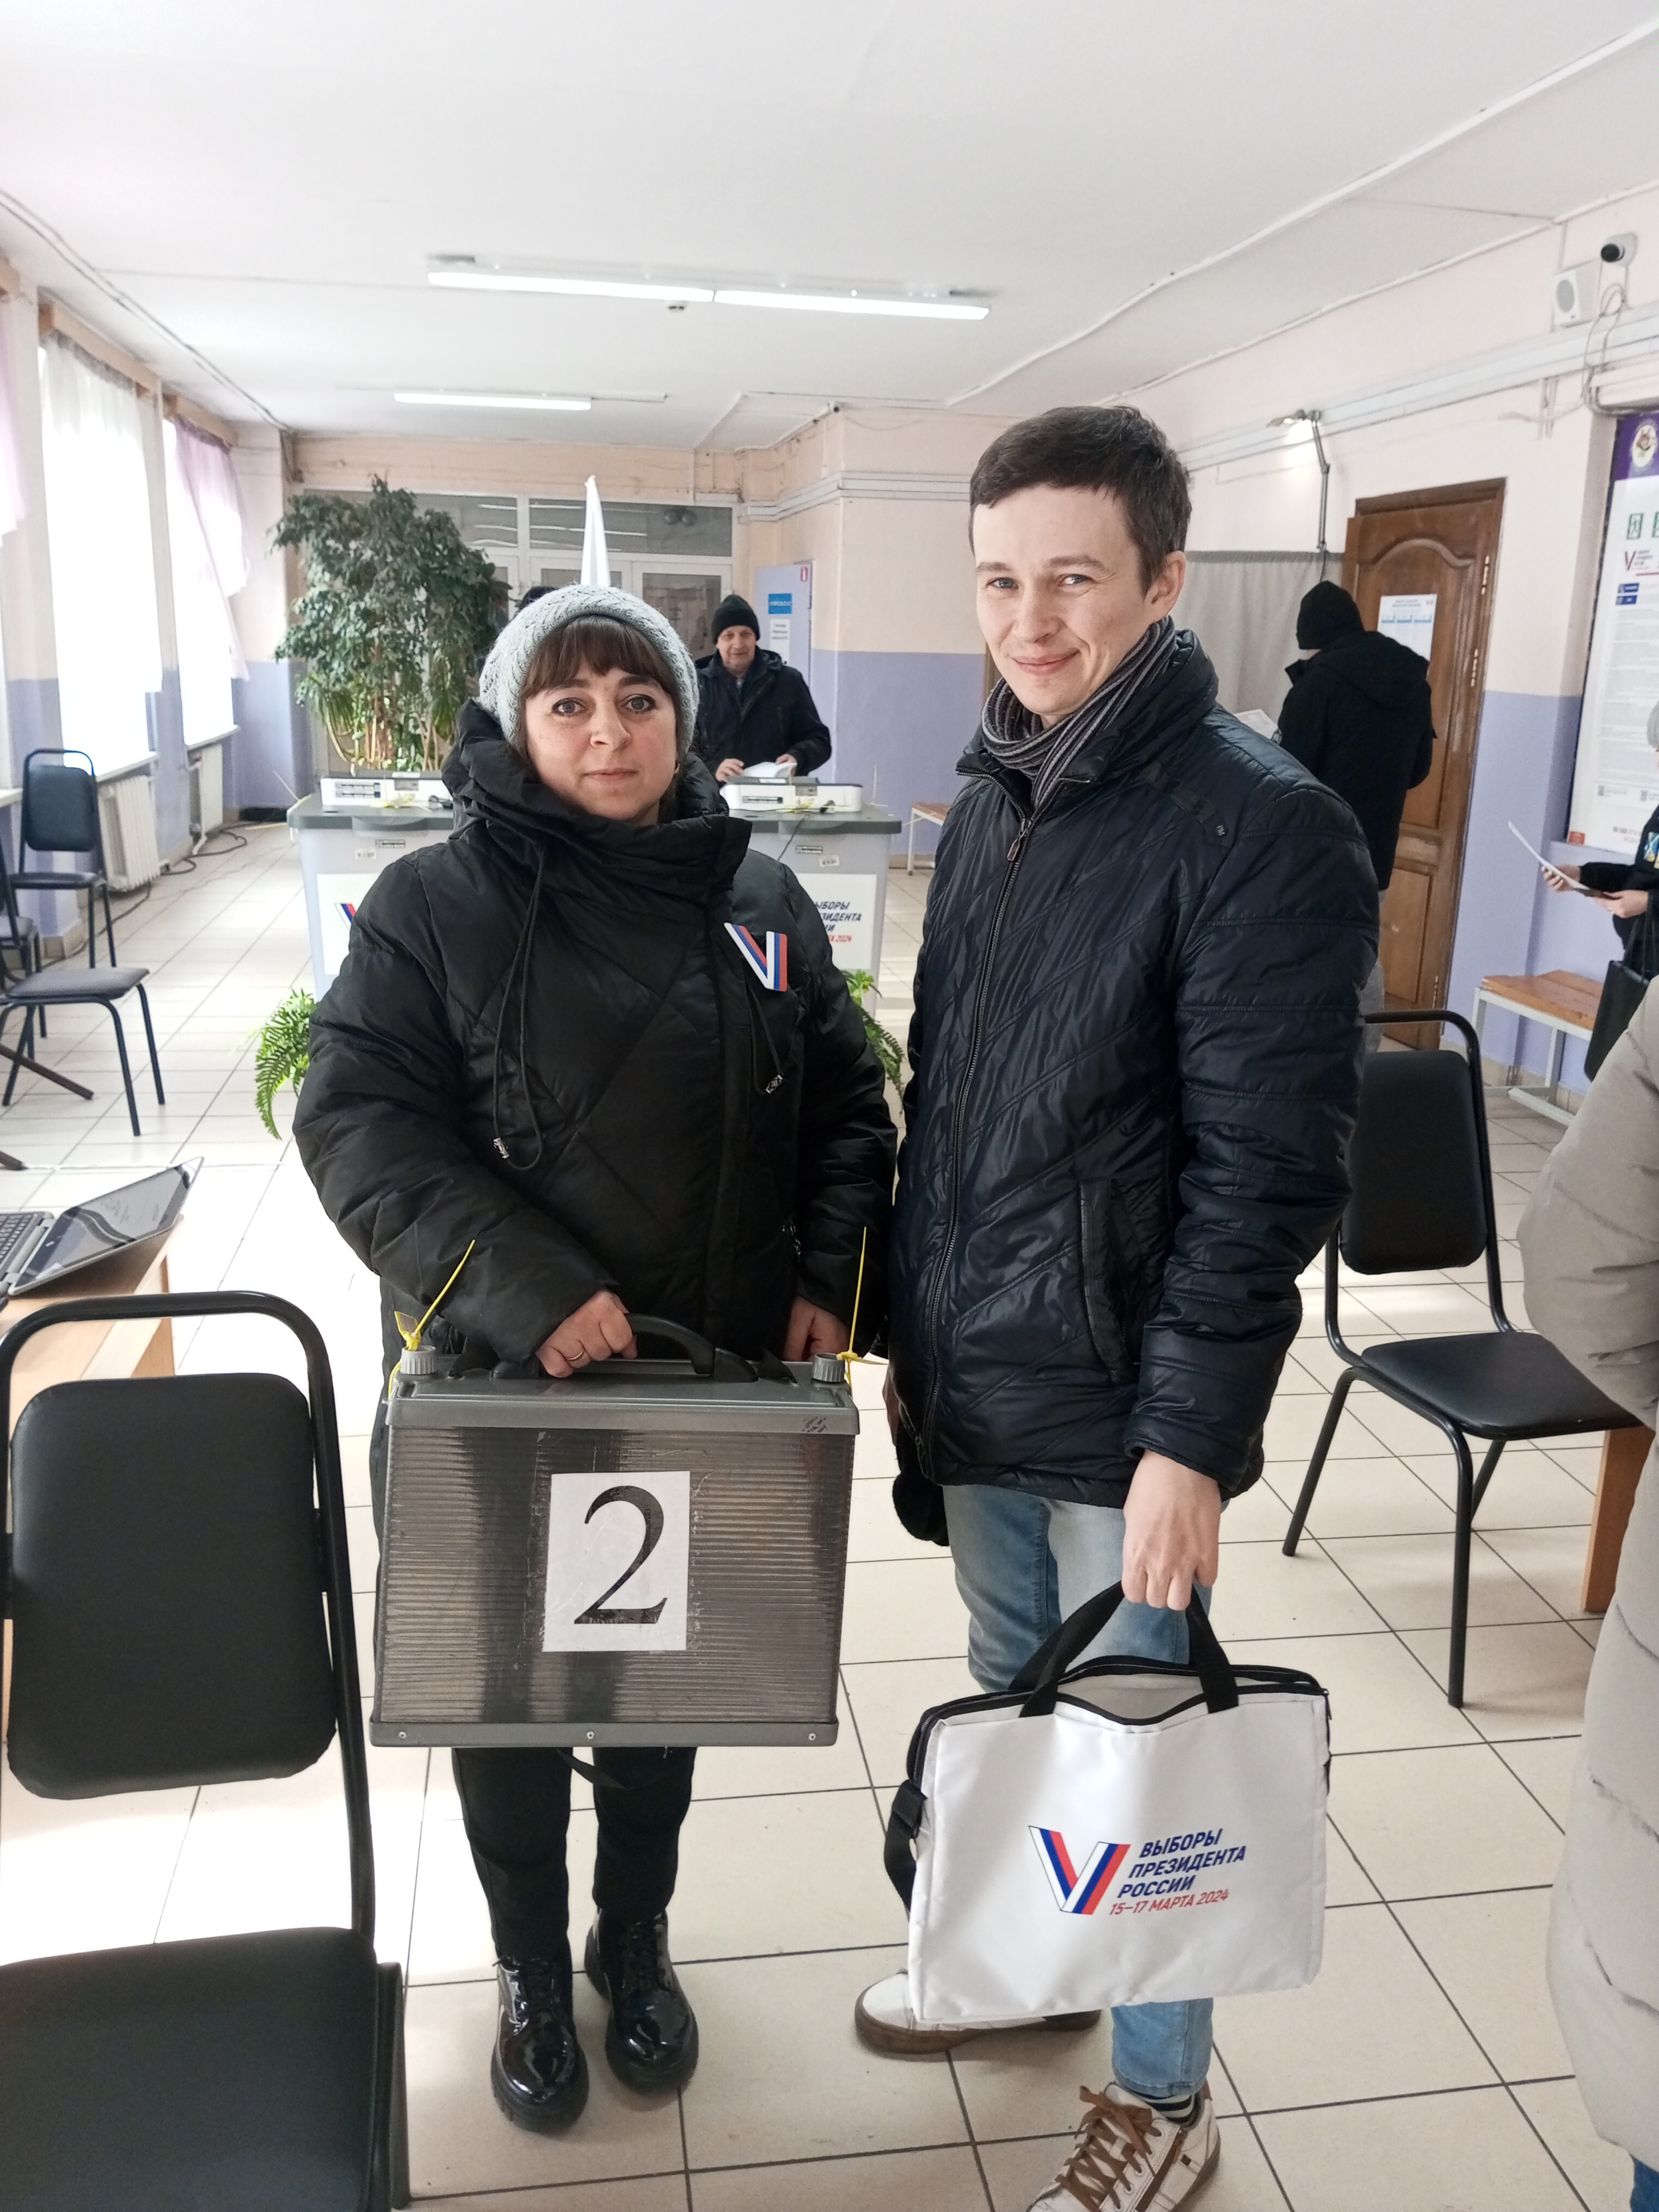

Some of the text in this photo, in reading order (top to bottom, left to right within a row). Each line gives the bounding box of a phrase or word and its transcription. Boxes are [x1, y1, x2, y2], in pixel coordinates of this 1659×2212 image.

[815, 901, 850, 910] ЫБОРЫ
[821, 913, 862, 922] ЗИДЕНТА
[574, 1485, 668, 1624] 2
[1139, 1828, 1224, 1859] ВЫБОРЫ
[1128, 1845, 1248, 1879] ПРЕЗИДЕНТА
[1117, 1875, 1196, 1899] РОССИИ
[1148, 1893, 1195, 1913] МАРТА
[1196, 1888, 1230, 1907] 2024
